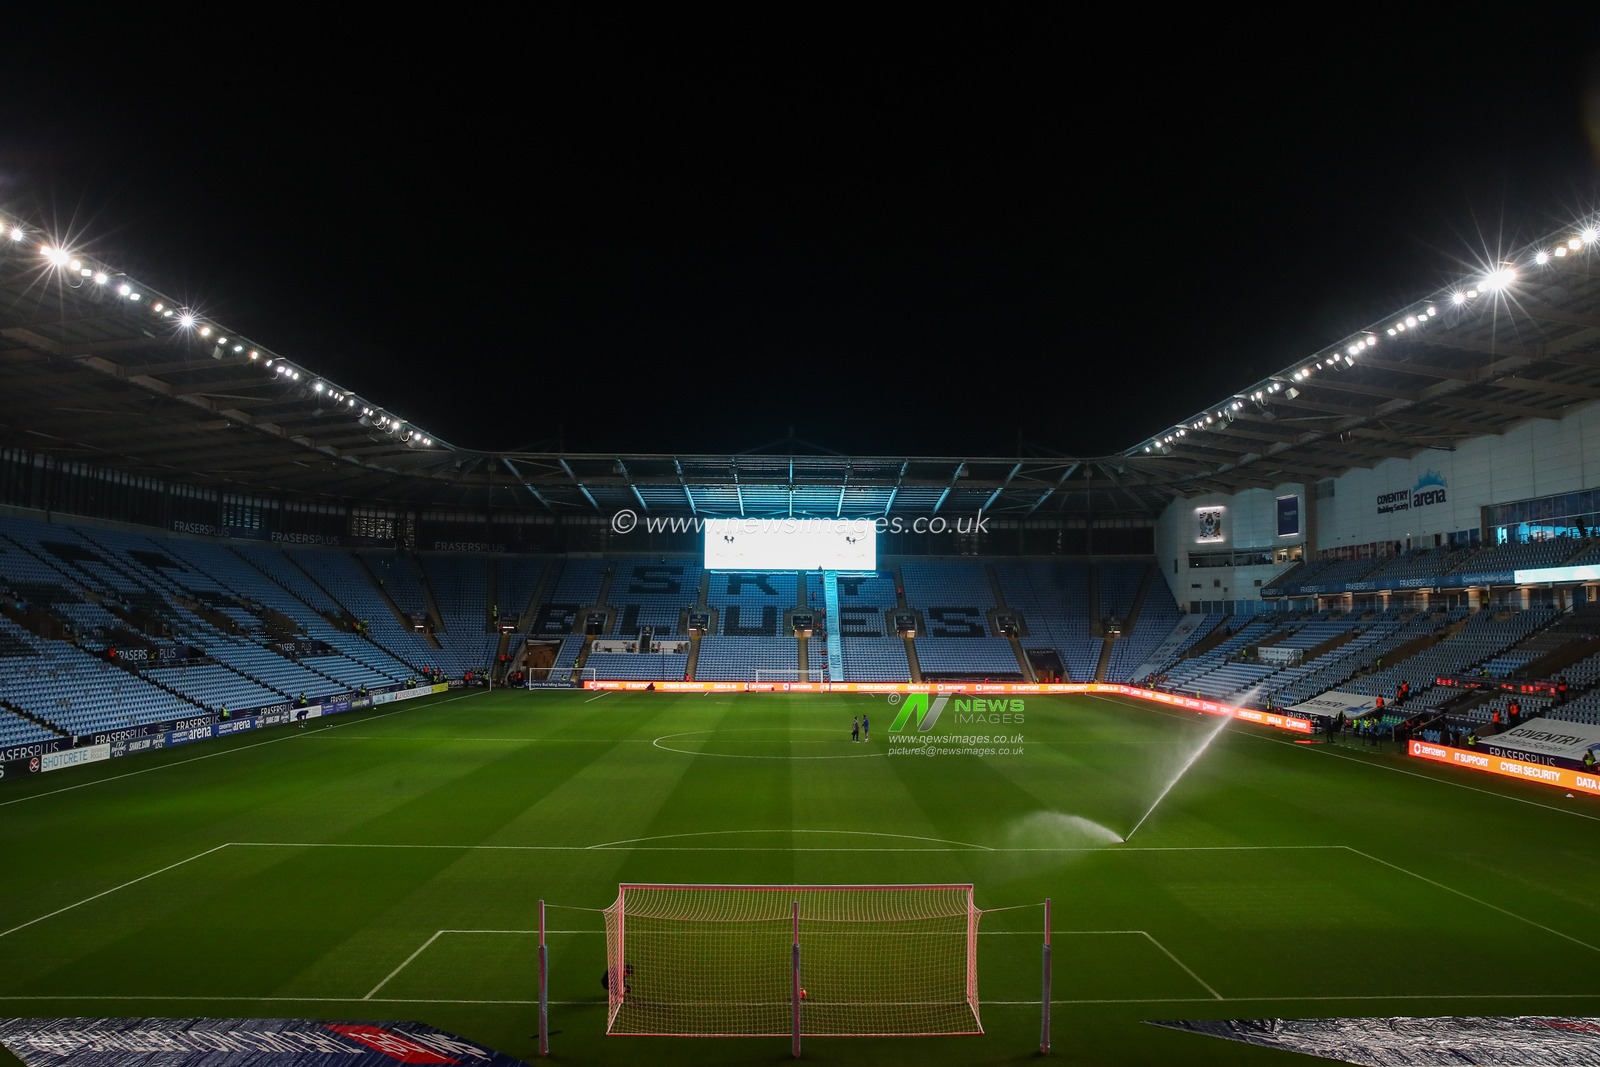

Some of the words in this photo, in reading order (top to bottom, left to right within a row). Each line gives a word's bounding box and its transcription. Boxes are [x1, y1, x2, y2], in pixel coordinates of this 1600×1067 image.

[1377, 490, 1408, 505] COVENTRY
[1413, 489, 1446, 508] arena
[174, 520, 230, 538] FRASERSPLUS
[271, 531, 340, 546] FRASERSPLUS
[1400, 578, 1436, 588] FRASERSPLUS
[160, 648, 176, 659] PLUS
[188, 726, 212, 740] arena
[232, 719, 251, 732] arena
[1508, 728, 1586, 746] COVENTRY
[42, 749, 88, 769] SHOTCRETE
[1421, 745, 1446, 758] zenzero
[1454, 753, 1460, 762] IT
[1460, 754, 1489, 767] SUPPORT
[1500, 761, 1523, 774] CYBER
[1524, 765, 1560, 782] SECURITY
[1576, 776, 1597, 790] DATA
